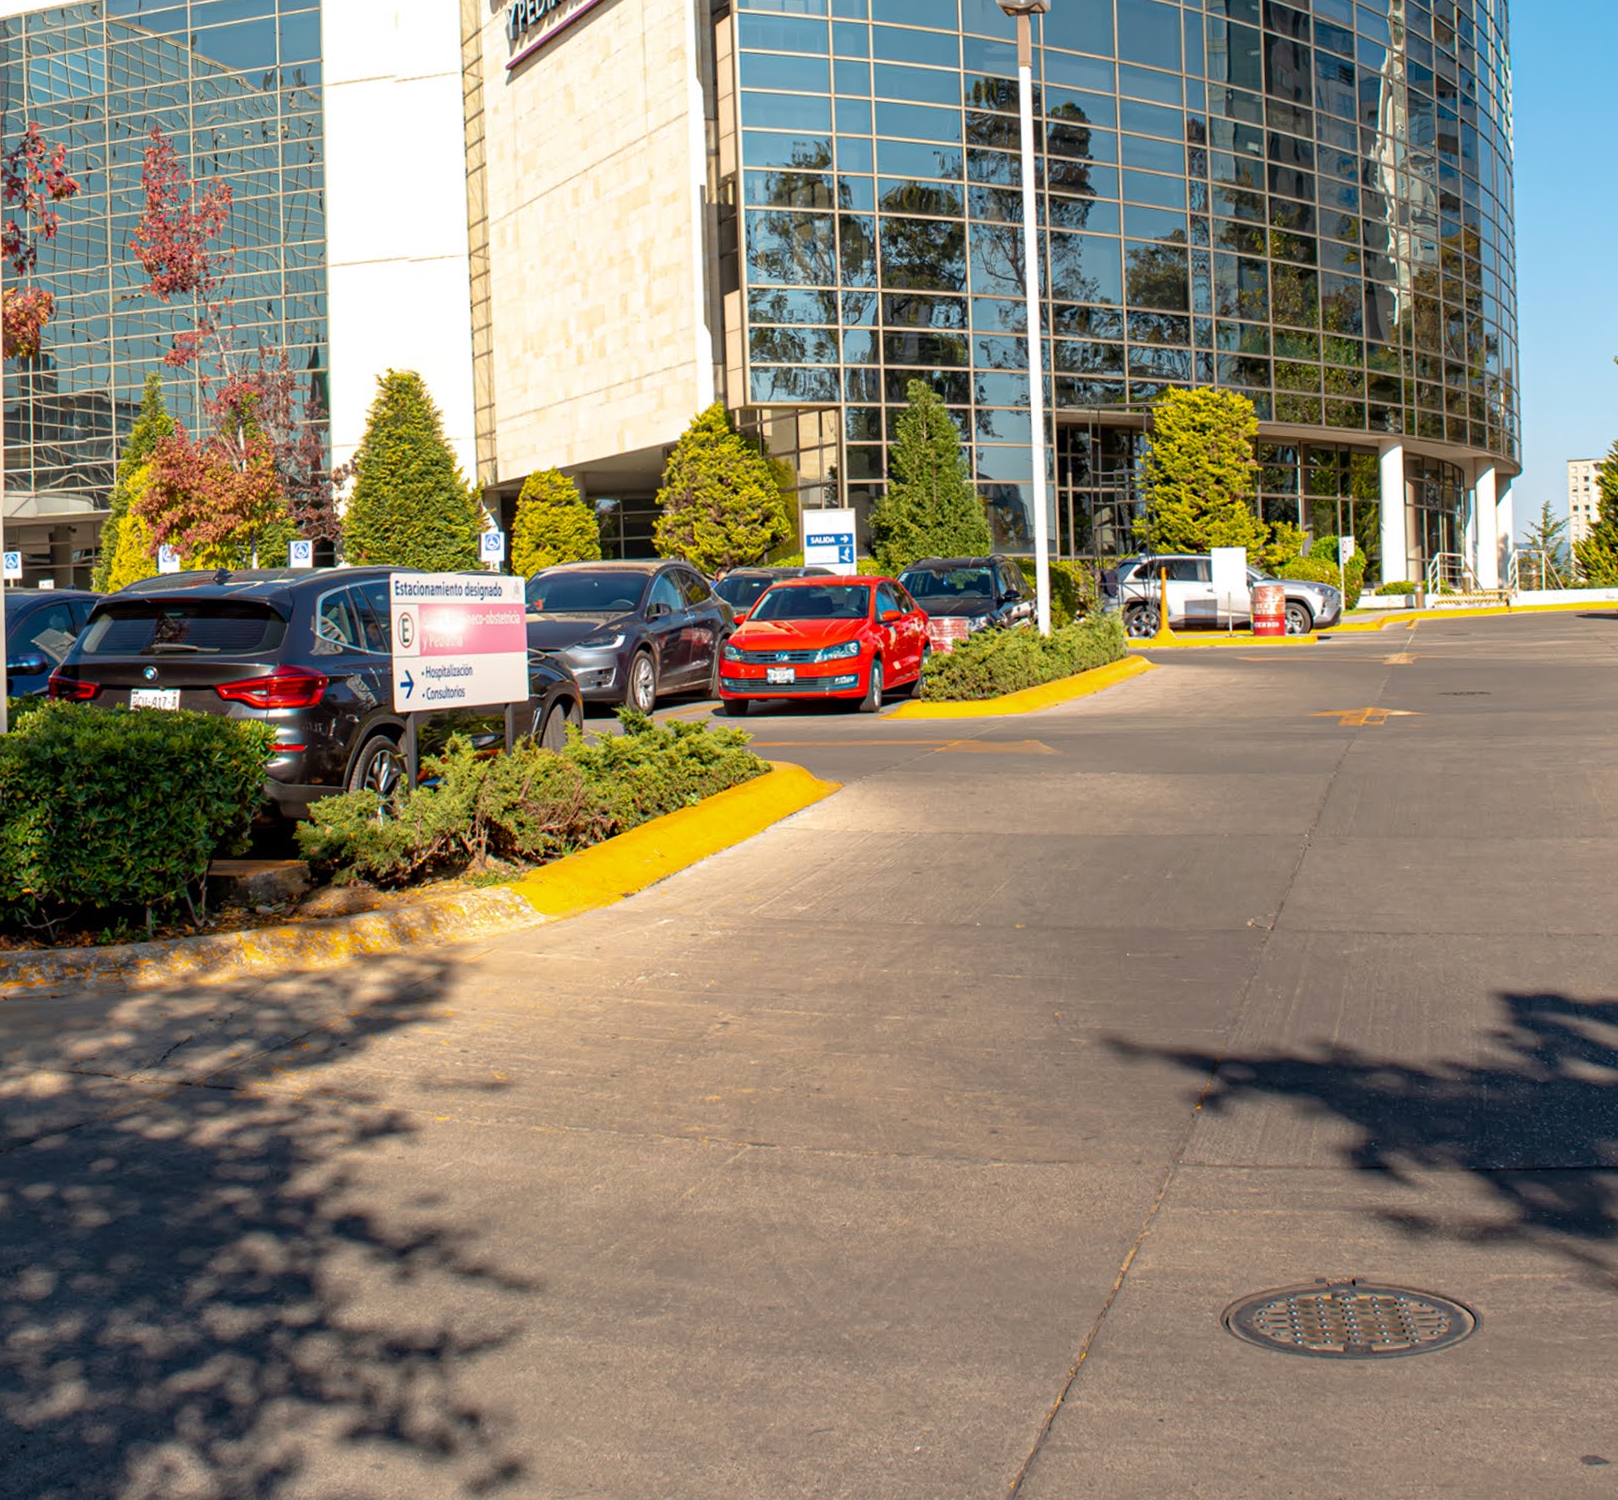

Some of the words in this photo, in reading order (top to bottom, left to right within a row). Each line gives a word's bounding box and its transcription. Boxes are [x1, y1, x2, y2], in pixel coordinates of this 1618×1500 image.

[505, 2, 519, 40] Y
[810, 536, 836, 544] SALIDA
[394, 580, 463, 597] Estacionamiento
[465, 582, 503, 600] designado
[425, 663, 474, 681] Hospitalización
[426, 685, 466, 701] Consultorios
